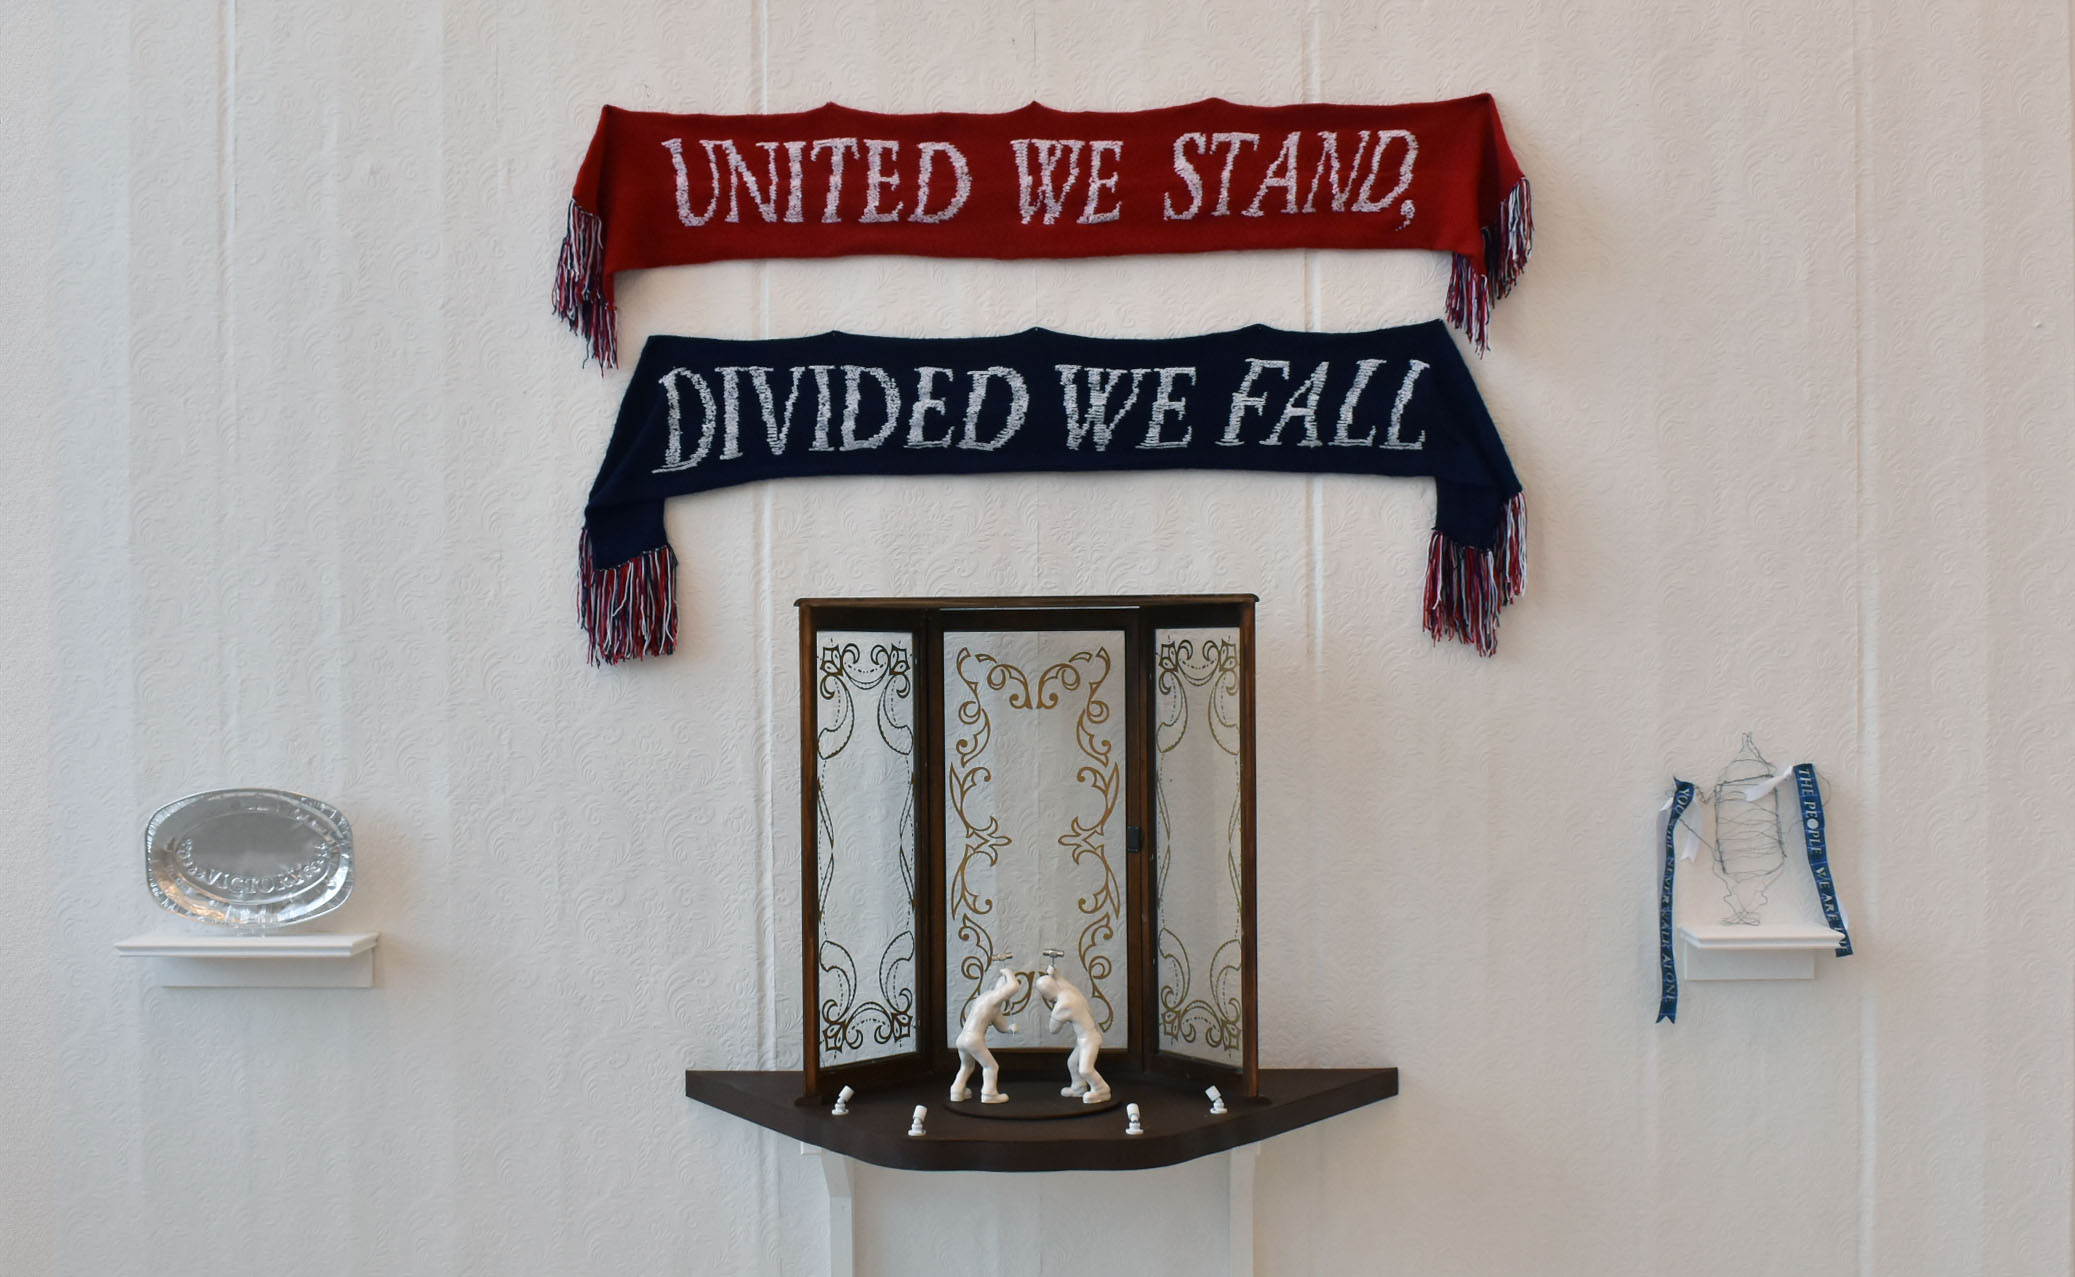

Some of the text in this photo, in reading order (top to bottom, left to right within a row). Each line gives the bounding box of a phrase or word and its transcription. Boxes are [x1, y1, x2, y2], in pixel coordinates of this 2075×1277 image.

[661, 130, 1418, 230] UNITED WE STAND,
[652, 358, 1430, 473] DIVIDED WE FALL
[1799, 769, 1814, 796] THE
[1676, 789, 1690, 814] YOU
[206, 864, 304, 894] VICTORY
[1816, 867, 1830, 889] WE
[1822, 895, 1838, 921] ARE
